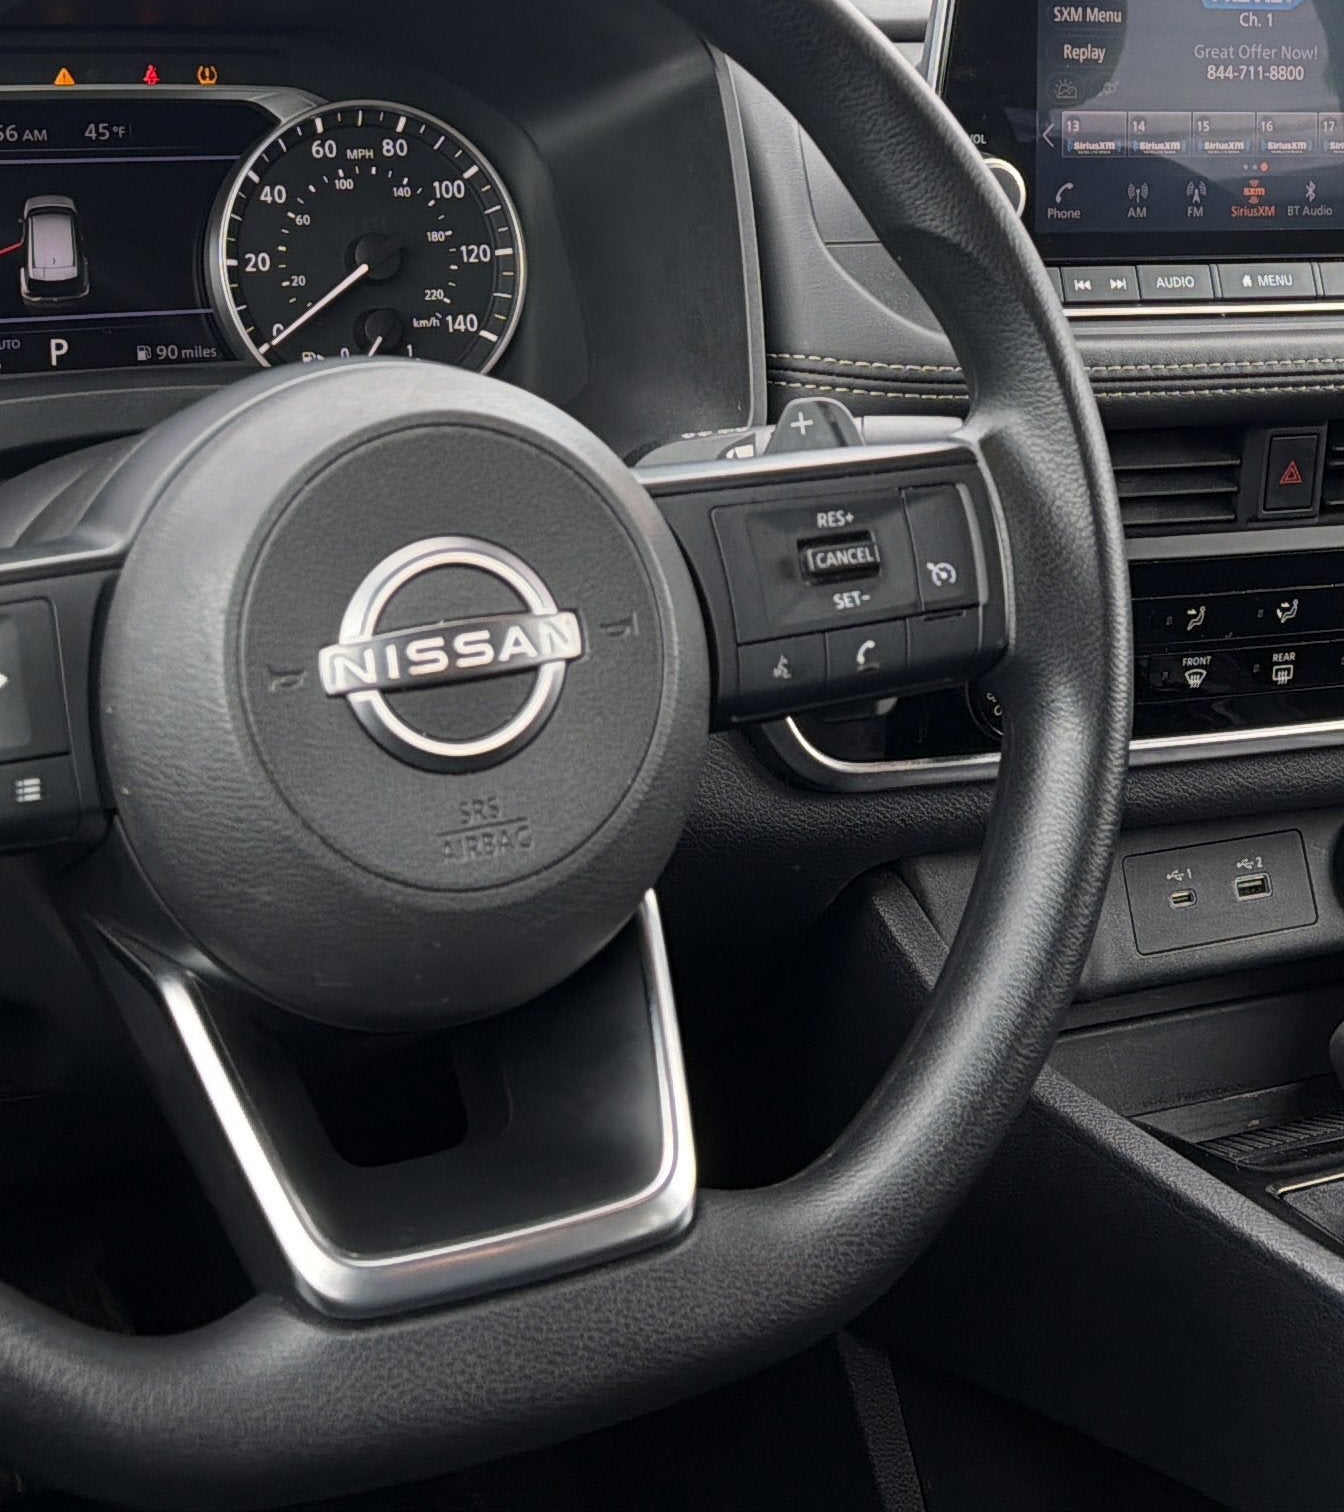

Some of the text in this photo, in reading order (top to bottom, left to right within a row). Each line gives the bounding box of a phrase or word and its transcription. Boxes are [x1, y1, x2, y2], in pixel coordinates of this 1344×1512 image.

[1054, 6, 1122, 23] SXM Menu
[1239, 12, 1273, 28] Ch. 1
[1063, 44, 1106, 64] Replay
[1194, 44, 1318, 60] Great Offer Now!
[1207, 64, 1304, 80] 844-711-8800
[1066, 120, 1080, 132] 13
[1132, 120, 1146, 132] 14
[1197, 120, 1210, 132] 15
[1261, 120, 1273, 132] 16
[1323, 120, 1335, 132] 17
[22, 129, 48, 141] AM
[311, 140, 337, 158] 60
[382, 138, 407, 157] 80
[346, 148, 374, 160] MPH
[334, 178, 354, 190] 100
[432, 180, 465, 199] 100
[260, 185, 286, 204] 40
[392, 186, 411, 198] 140
[1047, 207, 1081, 219] Phone
[1127, 207, 1147, 218] AM
[1187, 206, 1204, 217] FM
[1231, 206, 1276, 217] SiriusXM
[1287, 206, 1333, 216] BT Audio
[295, 214, 311, 226] 60
[427, 231, 445, 242] 180
[460, 245, 491, 263] 120
[244, 253, 271, 272] 20
[291, 275, 306, 287] 20
[1156, 276, 1195, 288] AUDIO
[1257, 274, 1293, 286] MENU
[424, 289, 444, 300] 220
[413, 316, 441, 329] km/h
[446, 314, 478, 332] 140
[51, 339, 69, 366] P
[156, 344, 217, 360] 90 miles
[817, 511, 854, 528] RES+
[815, 548, 875, 569] CANCEL
[832, 592, 871, 609] SET-
[334, 619, 571, 686] NISSAN
[1272, 652, 1296, 663] REAR
[1182, 656, 1212, 667] FRONT
[460, 795, 501, 825] SRS
[443, 825, 533, 860] AIRBAG
[1255, 856, 1263, 868] 2
[1186, 868, 1193, 879] 1
